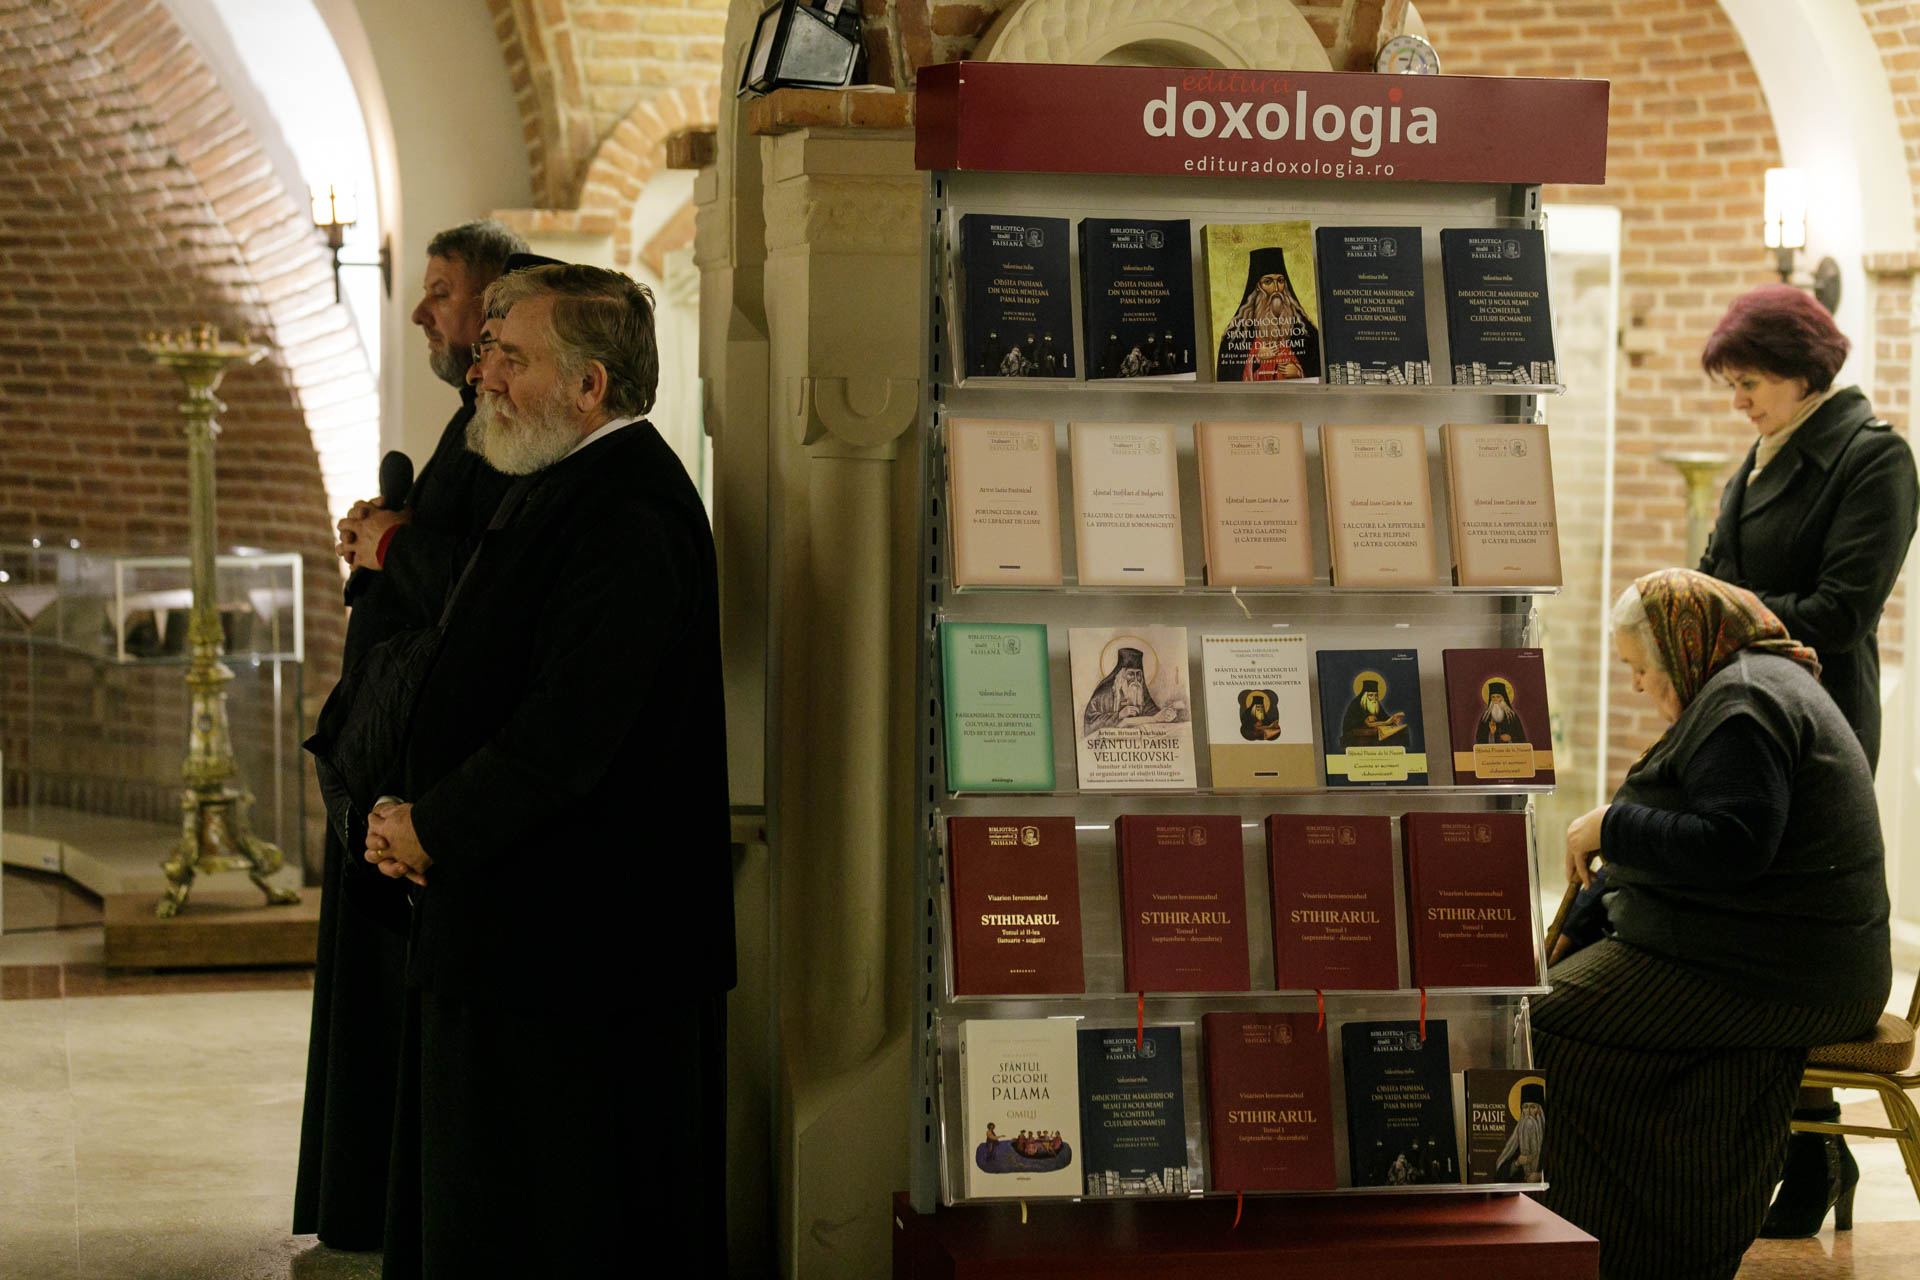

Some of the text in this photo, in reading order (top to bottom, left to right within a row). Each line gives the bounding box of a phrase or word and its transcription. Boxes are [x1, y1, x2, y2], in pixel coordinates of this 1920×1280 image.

[1143, 87, 1438, 158] doxologia
[1184, 156, 1395, 177] edituradoxologia.ro
[1230, 317, 1300, 327] AUTOBIOGRAFIA
[1271, 328, 1304, 337] CUVIOS
[1228, 342, 1252, 350] PAISIE
[1255, 341, 1265, 349] DE
[1087, 738, 1179, 749] SFÂNTUL PAISIE
[981, 914, 1059, 925] STIHIRARUL
[1141, 912, 1230, 924] STIHIRARUL
[1291, 910, 1379, 923] STIHIRARUL
[1428, 908, 1516, 920] STIHIRARUL
[992, 1074, 1048, 1084] GRIGORIE
[992, 1088, 1050, 1100] PALAMA
[1229, 1111, 1317, 1123] STIHIRARUL
[1473, 1111, 1505, 1122] PAISIE
